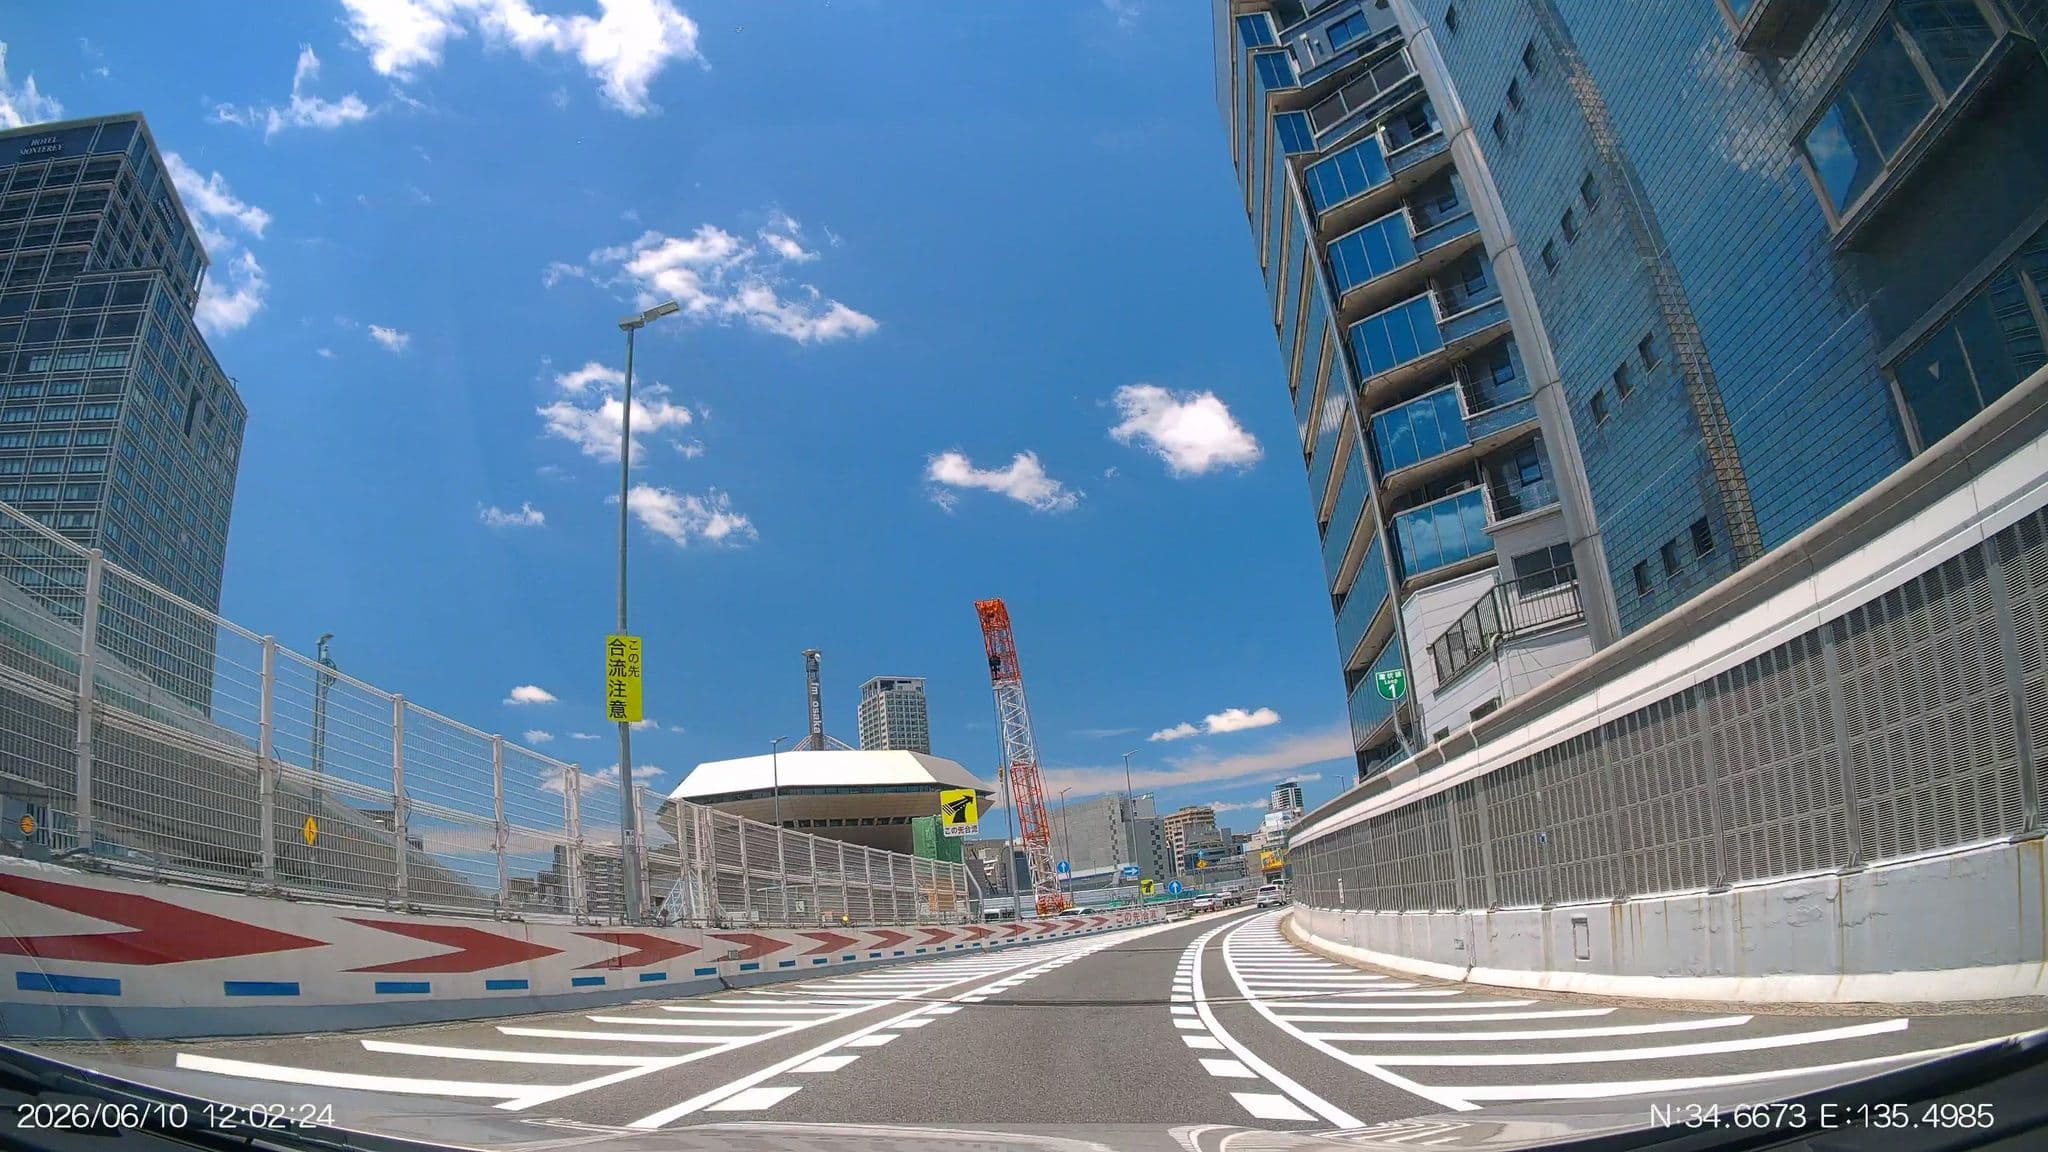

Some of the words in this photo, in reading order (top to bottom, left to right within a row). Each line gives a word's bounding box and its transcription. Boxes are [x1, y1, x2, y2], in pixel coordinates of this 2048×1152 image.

[31, 136, 57, 146] HOTEL
[628, 640, 640, 677] この先
[608, 638, 627, 719] 合流注意
[1389, 684, 1396, 698] 1
[812, 700, 822, 734] osaka
